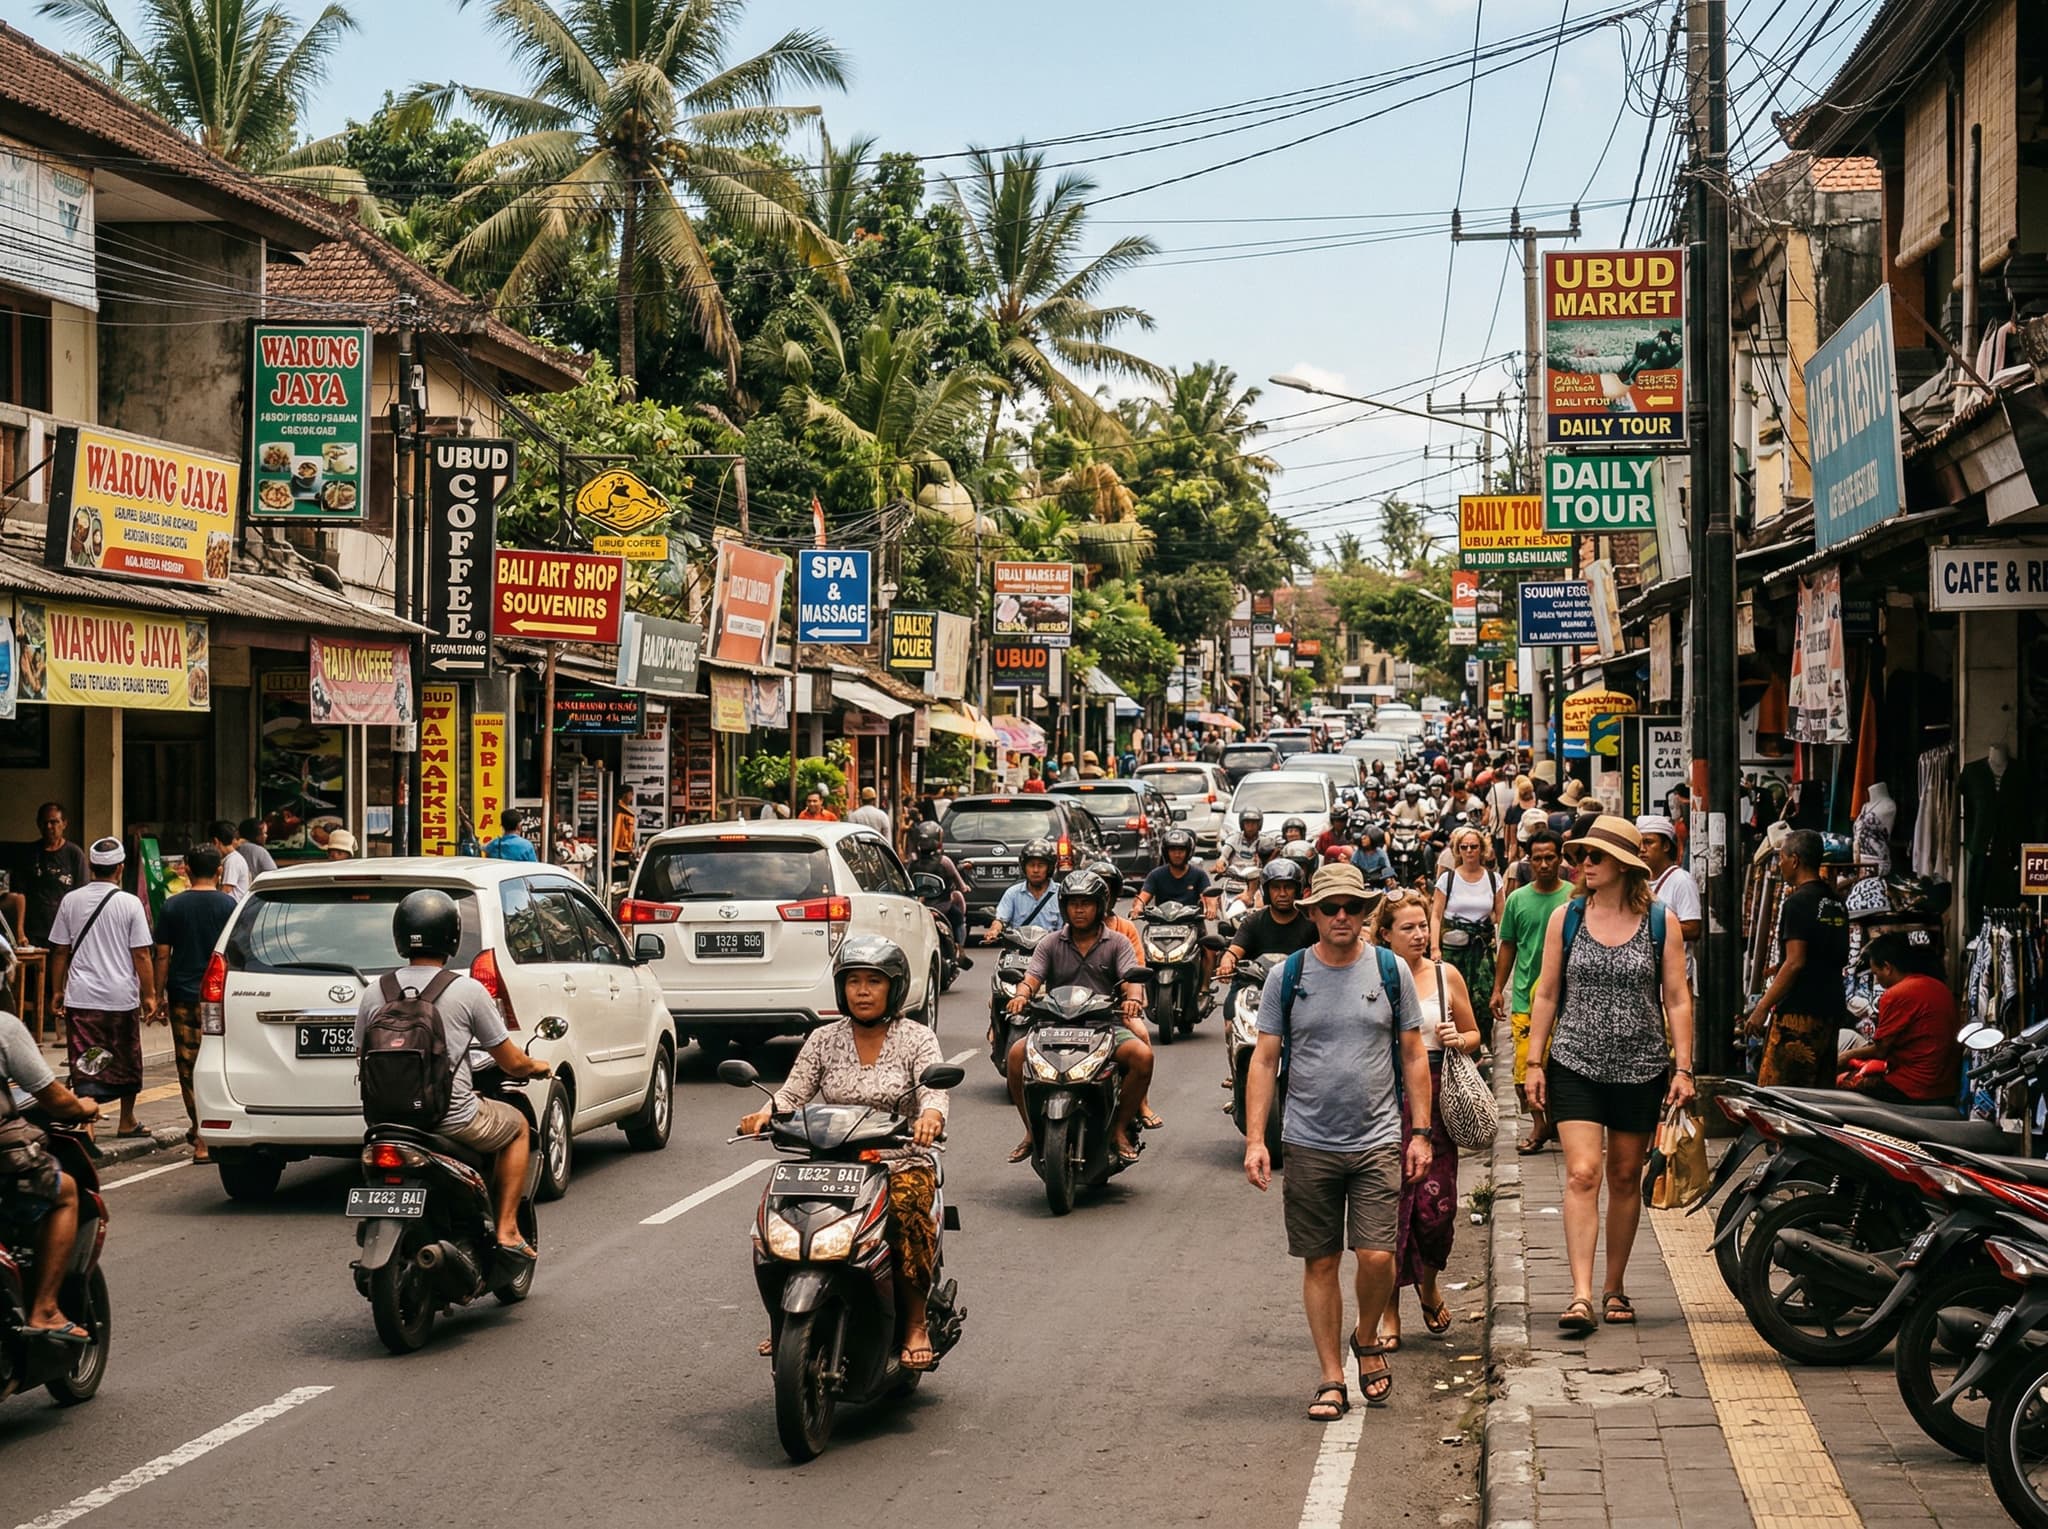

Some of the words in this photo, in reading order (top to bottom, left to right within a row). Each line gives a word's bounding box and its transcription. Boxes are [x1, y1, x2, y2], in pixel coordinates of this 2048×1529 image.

[1554, 257, 1675, 289] UBUD
[1554, 291, 1676, 316] MARKET
[261, 336, 360, 367] WARUNG
[271, 372, 348, 406] JAYA
[1560, 418, 1614, 435] DAILY
[1619, 417, 1672, 435] TOUR
[1809, 364, 1838, 463] CAFE
[437, 446, 509, 469] UBUD
[86, 444, 177, 504] WARUNG
[181, 466, 228, 514] JAYA
[1552, 461, 1653, 490] DAILY
[1464, 501, 1507, 531] BAILY
[1552, 495, 1653, 524] TOUR
[1497, 536, 1520, 546] ART
[498, 558, 533, 586] BALI
[537, 561, 571, 589] ART
[574, 563, 618, 591] SHOP
[811, 556, 858, 579] SPA
[1944, 561, 1998, 593] CAFE
[2005, 561, 2021, 592] &
[502, 591, 607, 619] SOUVENIRS
[827, 582, 841, 601] &
[802, 604, 866, 623] MASSAGE
[50, 613, 135, 666] WARUNG
[141, 624, 183, 669] JAYA
[996, 648, 1047, 668] UBUD
[424, 692, 453, 703] BUD
[837, 1168, 860, 1182] BAL
[401, 1191, 422, 1205] BAL
